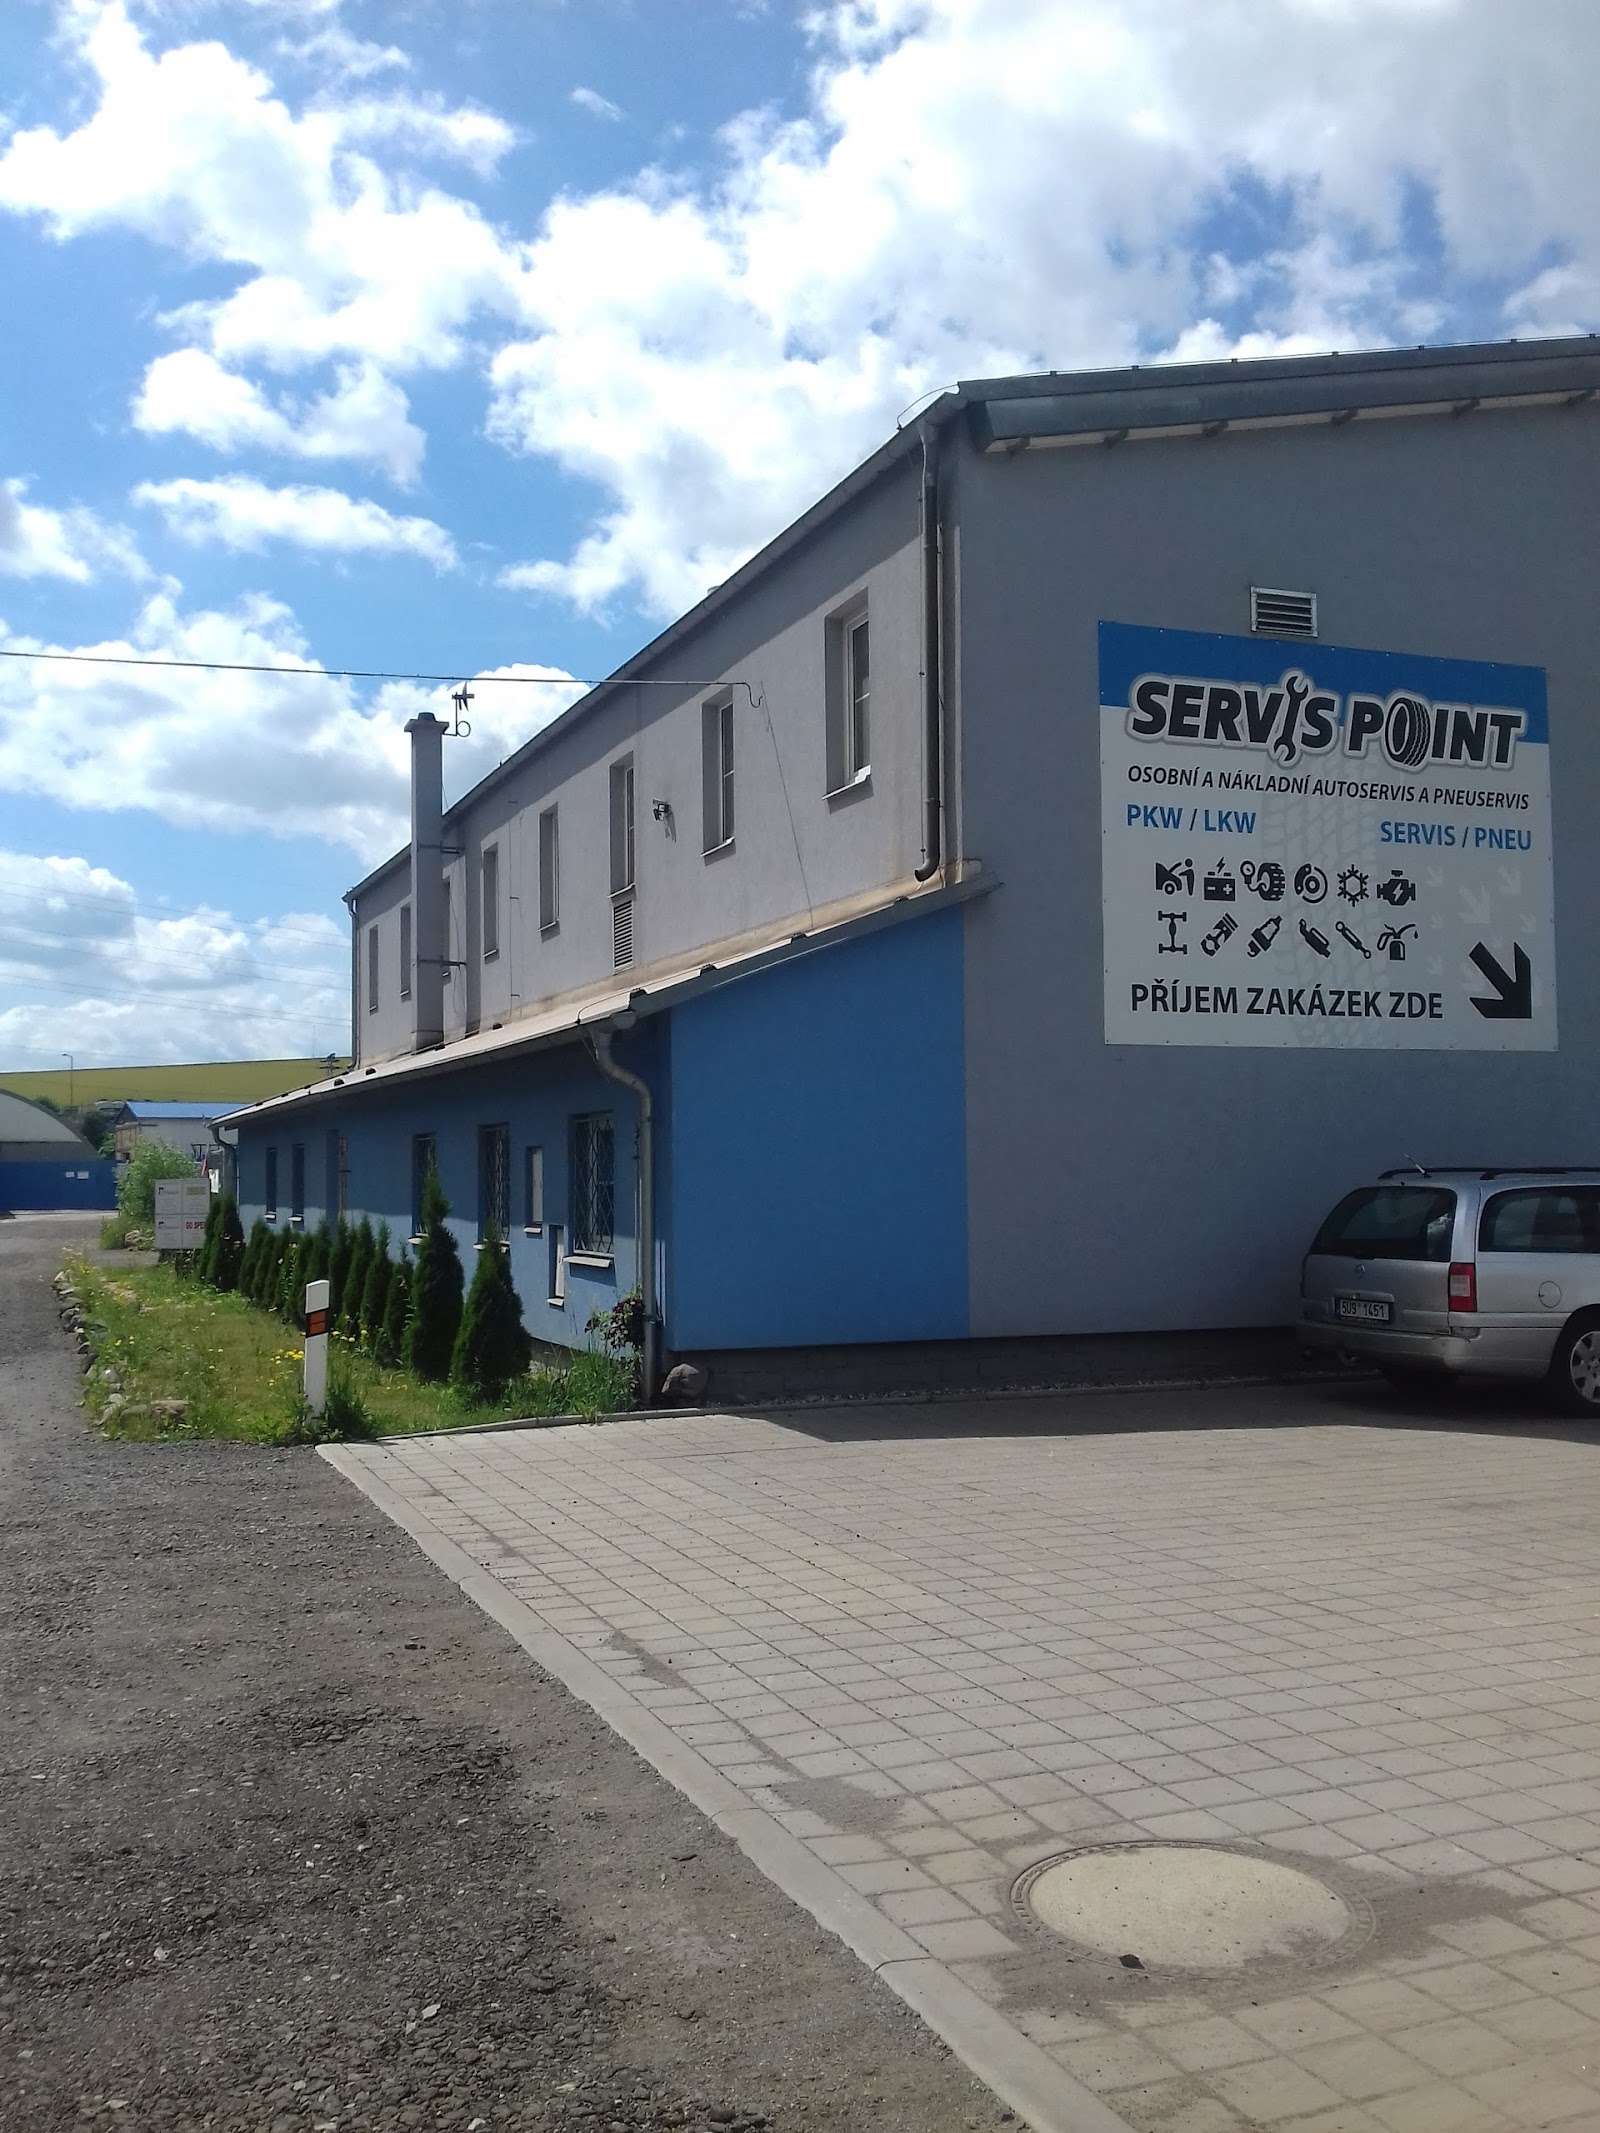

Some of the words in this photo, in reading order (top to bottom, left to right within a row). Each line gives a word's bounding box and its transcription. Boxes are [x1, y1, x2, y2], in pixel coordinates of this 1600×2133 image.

[1132, 675, 1336, 762] SERVIS
[1348, 697, 1522, 767] POINT
[1128, 765, 1201, 787] OSOBNÍ
[1201, 770, 1214, 789] A
[1218, 769, 1311, 795] NÁKLADNÍ
[1312, 778, 1416, 802] AUTOSERVIS
[1418, 786, 1430, 804] A
[1433, 788, 1530, 810] PNEUSERVIS
[1126, 804, 1183, 829] PKW
[1188, 807, 1198, 832] /
[1203, 809, 1257, 834] LKW
[1379, 820, 1456, 846] SERVIS
[1461, 826, 1470, 849] /
[1474, 826, 1532, 851] PNEU
[1130, 978, 1239, 1015] PŘÍJEM
[1245, 983, 1382, 1018] ZAKÁZEK
[1388, 991, 1444, 1020] ZDE
[1363, 1303, 1385, 1319] 1451
